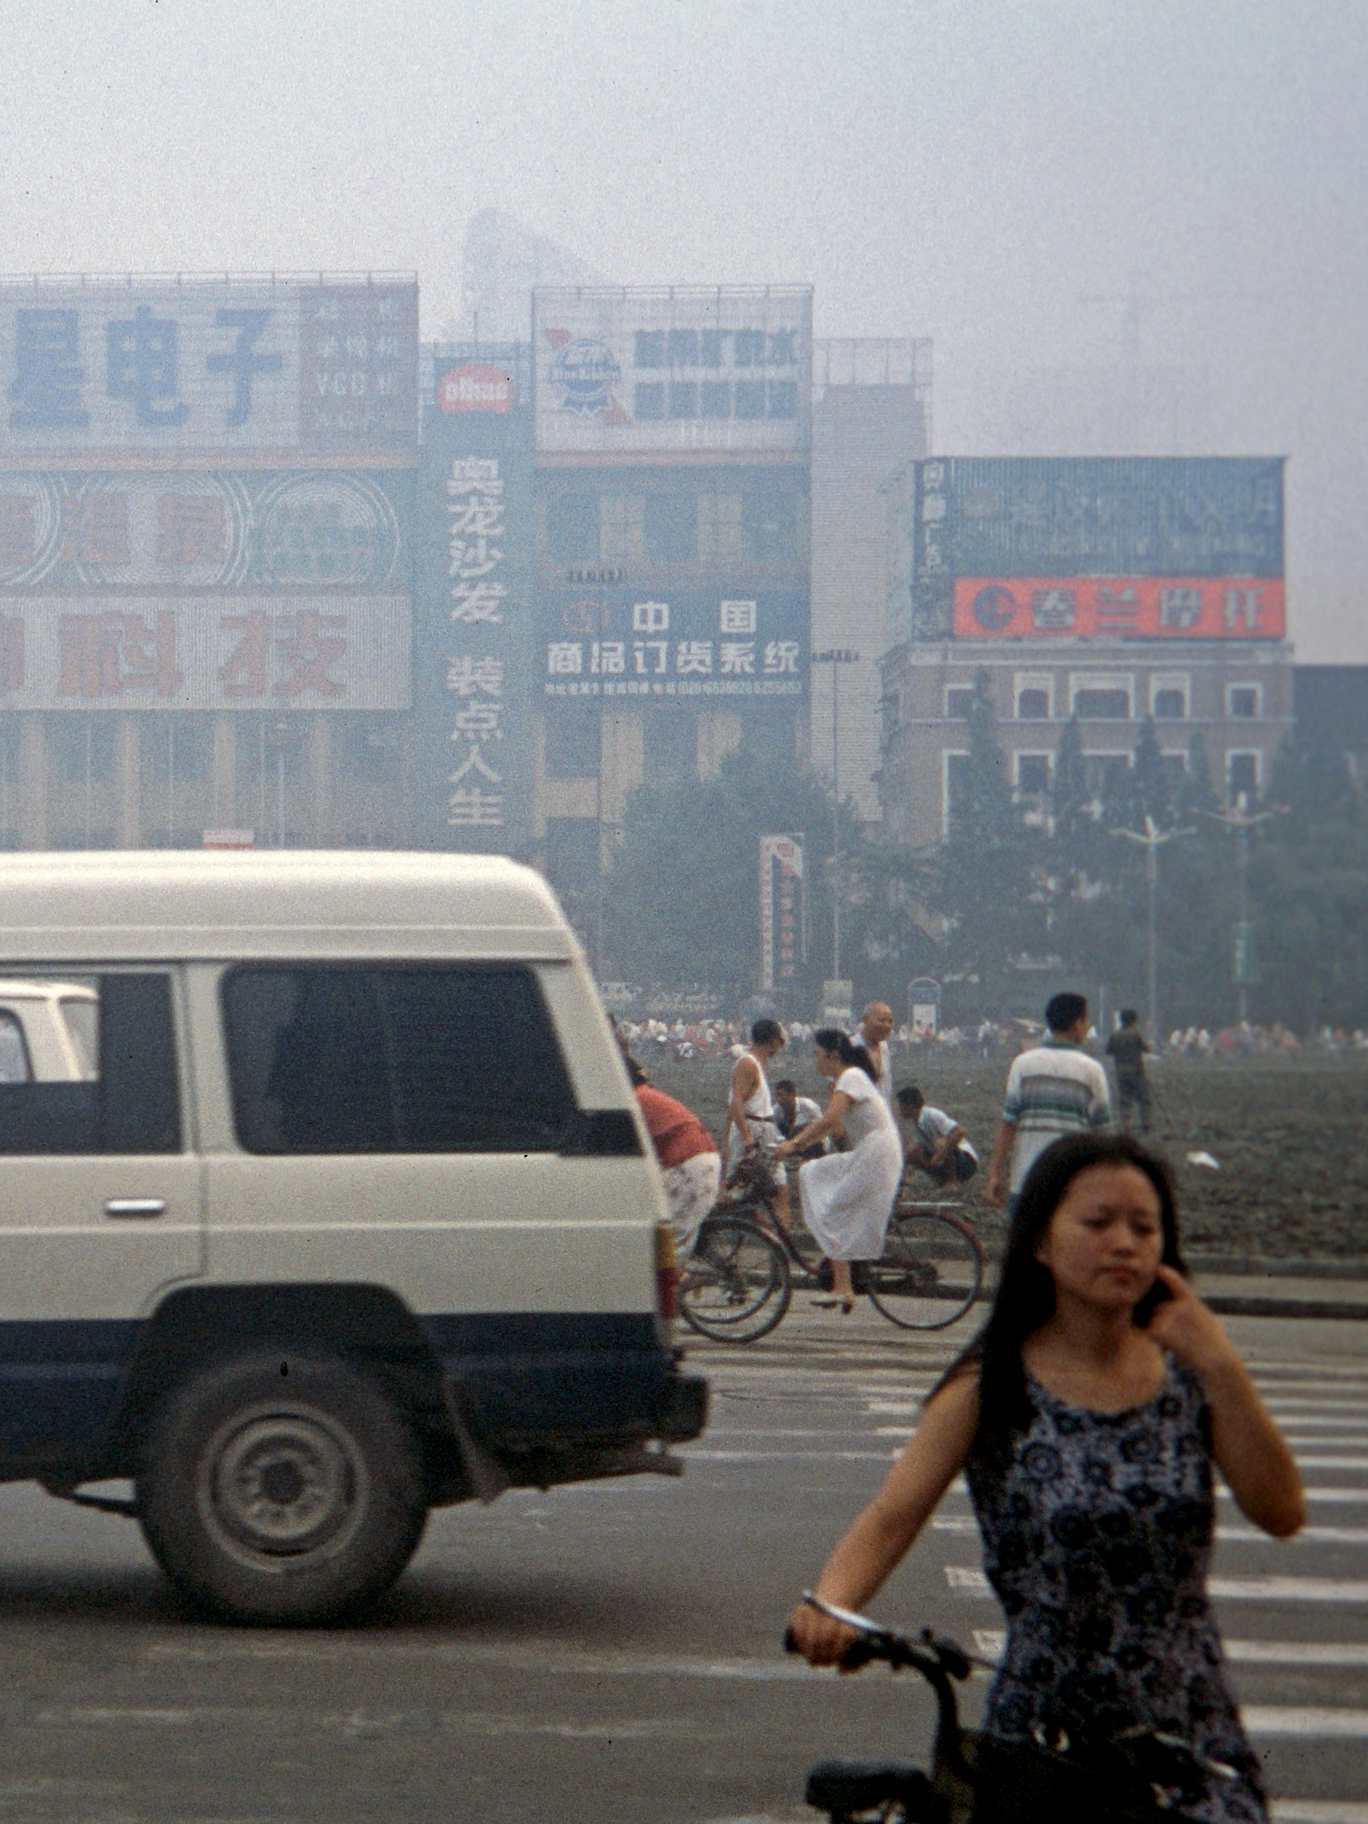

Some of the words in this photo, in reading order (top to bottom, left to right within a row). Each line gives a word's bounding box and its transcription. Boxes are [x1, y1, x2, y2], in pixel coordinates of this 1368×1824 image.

[445, 455, 510, 625] 奥龙沙发
[632, 600, 757, 634] 中国
[1032, 586, 1266, 631] 春兰摩托
[546, 641, 801, 675] 商品订货系统
[445, 655, 506, 827] 装点人生
